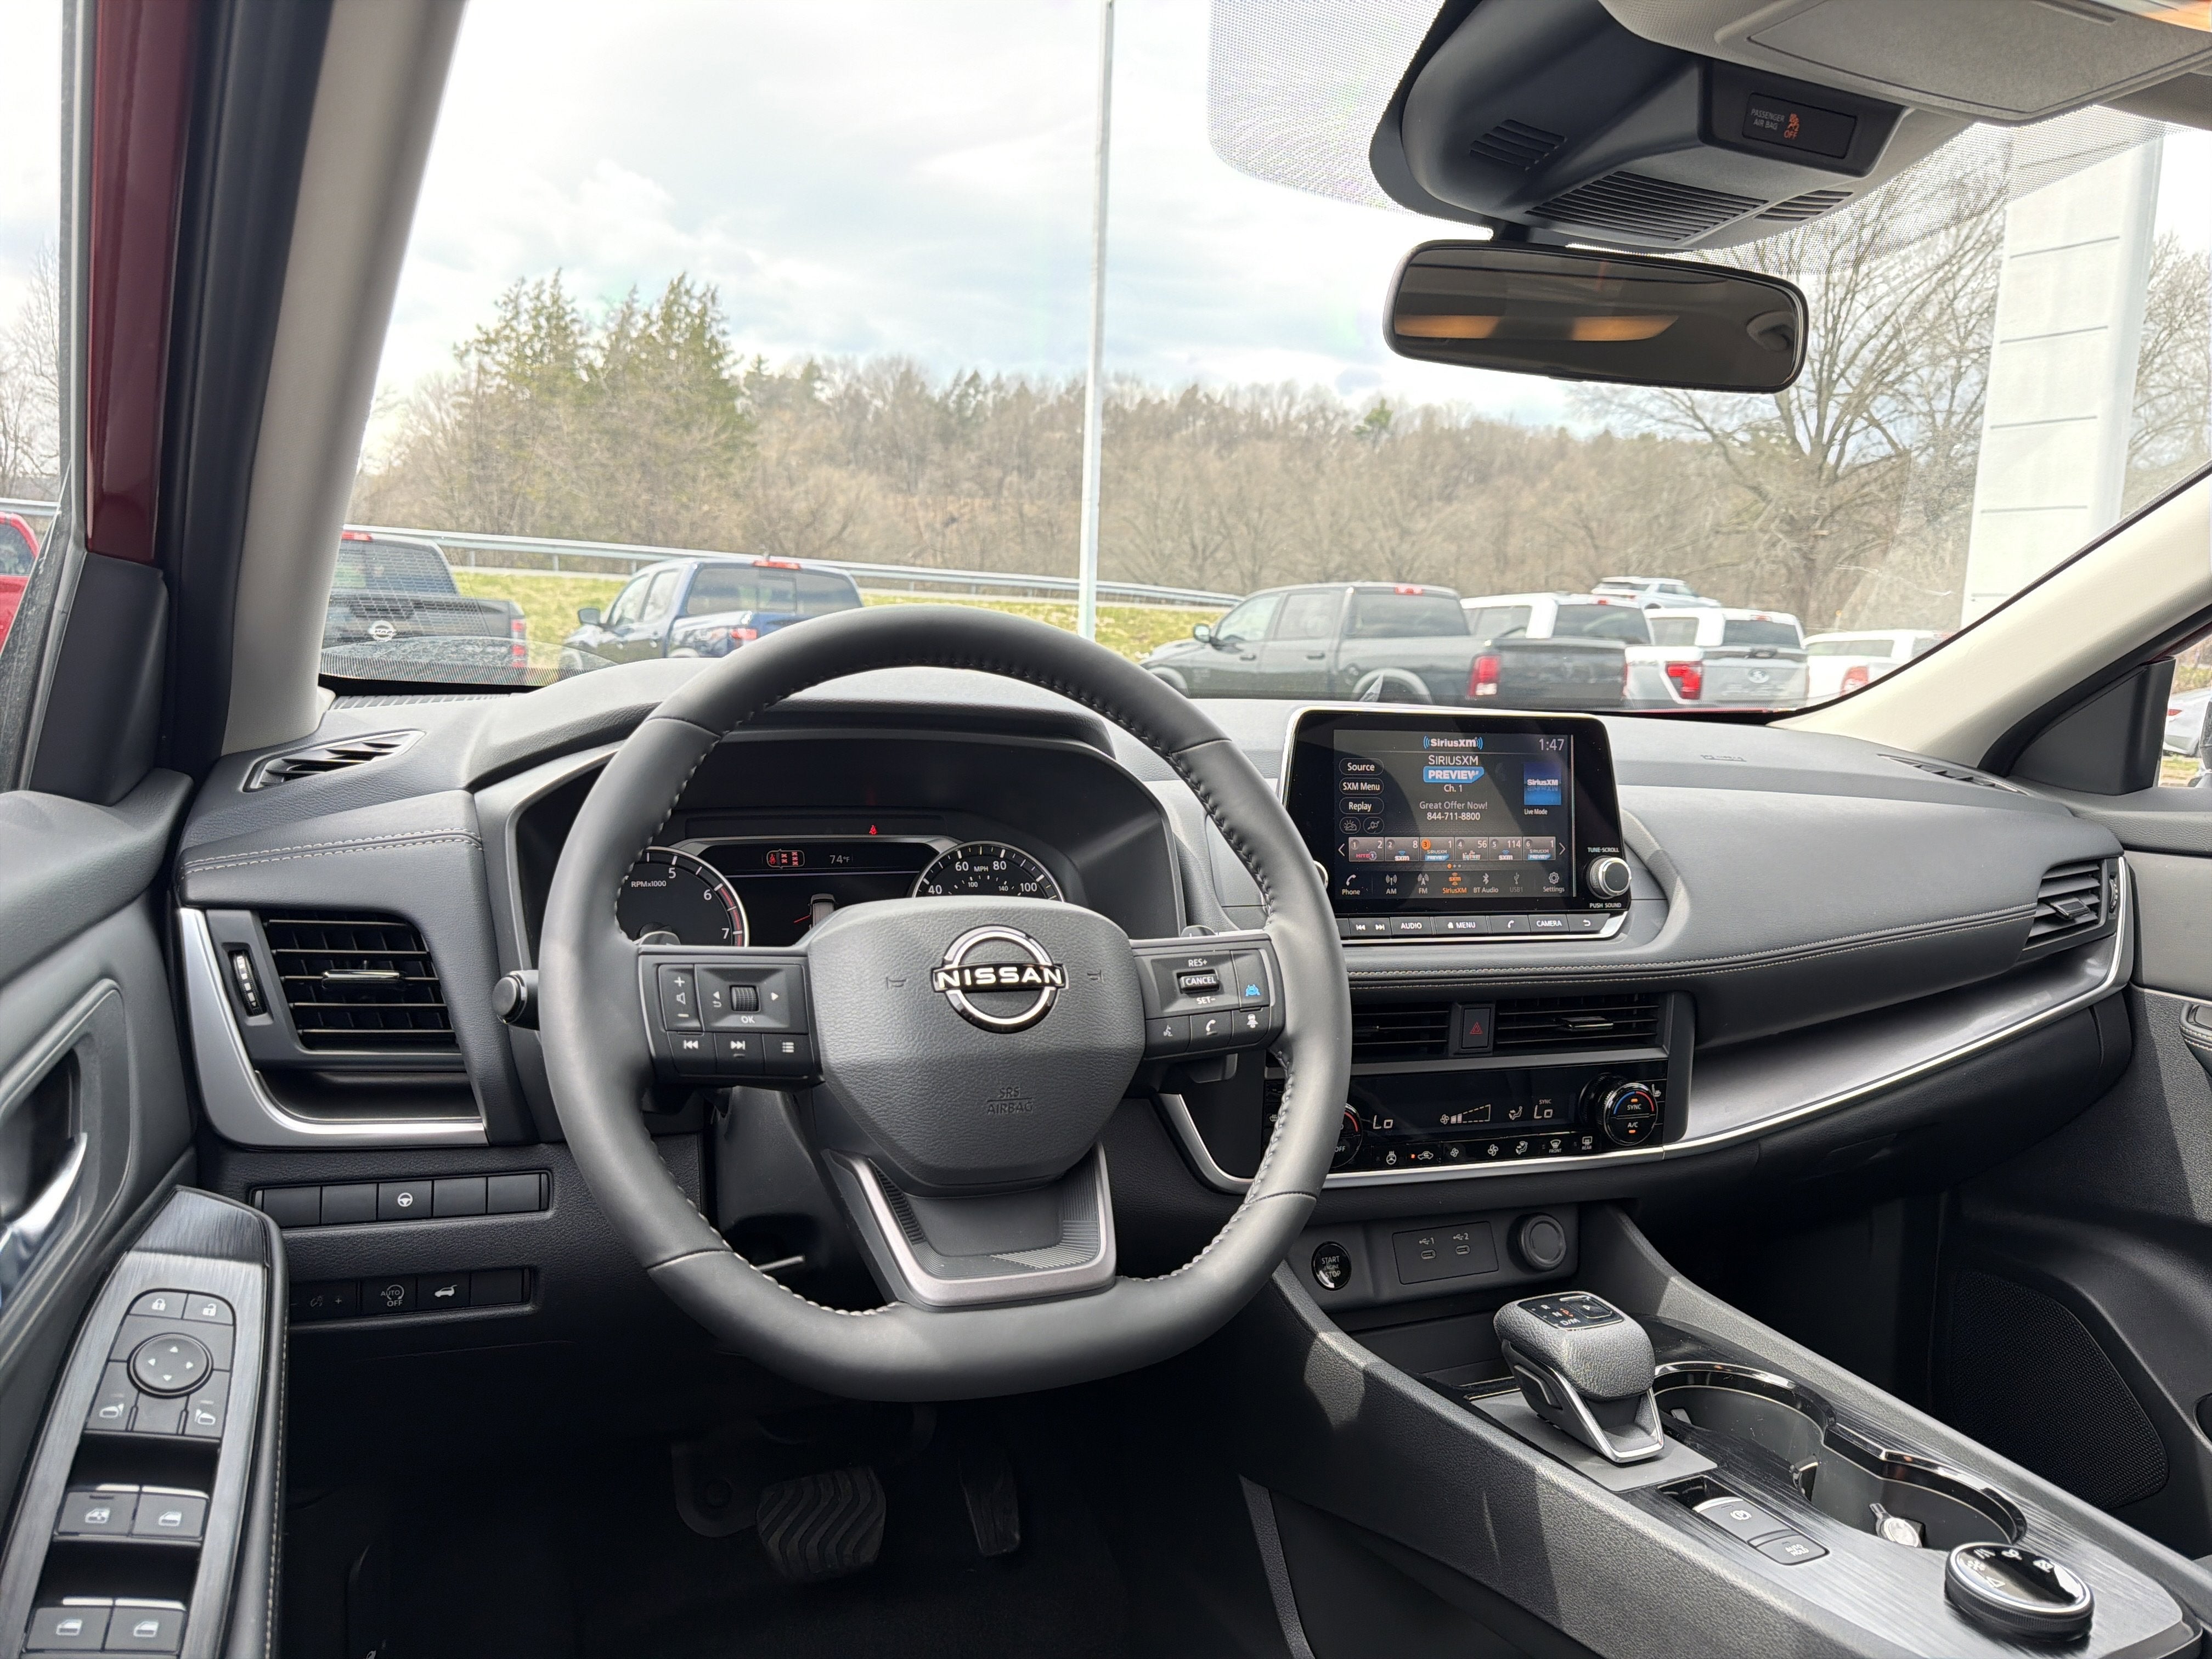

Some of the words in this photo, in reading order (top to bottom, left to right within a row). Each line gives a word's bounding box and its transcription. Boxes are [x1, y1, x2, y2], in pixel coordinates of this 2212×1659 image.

[1751, 109, 1785, 122] PASSENGER
[1753, 119, 1764, 127] AIR
[1765, 121, 1778, 130] BAG
[1784, 130, 1798, 139] OFF
[1539, 738, 1565, 751] 1:47
[1428, 755, 1479, 766] SIRIUSXM
[1347, 762, 1375, 771] Source
[1428, 770, 1479, 780] PREVIEW
[1342, 782, 1359, 791] SXM
[1360, 782, 1380, 791] Menu
[1348, 802, 1372, 812] Replay
[1419, 801, 1442, 810] Great
[1443, 801, 1466, 810] Offer
[1467, 801, 1488, 810] Now!
[1427, 812, 1481, 821] 844-711-8800
[1377, 840, 1383, 849] 2
[1448, 840, 1452, 848] 1
[1477, 840, 1487, 848] 56
[1507, 840, 1521, 848] 114
[955, 861, 969, 871] 60
[993, 861, 1006, 870] 80
[668, 867, 676, 879] 5
[928, 885, 942, 894] 40
[1020, 882, 1037, 892] 100
[703, 889, 712, 900] 6
[721, 928, 730, 939] 7
[1188, 958, 1207, 967] RES+
[937, 967, 1062, 988] NISSAN
[1186, 976, 1216, 985] CANCEL
[999, 1087, 1019, 1098] SRS
[988, 1101, 1033, 1114] AIRBAG
[1321, 1255, 1340, 1265] START
[1325, 1270, 1341, 1278] STOP
[1560, 1318, 1581, 1326] D/M
